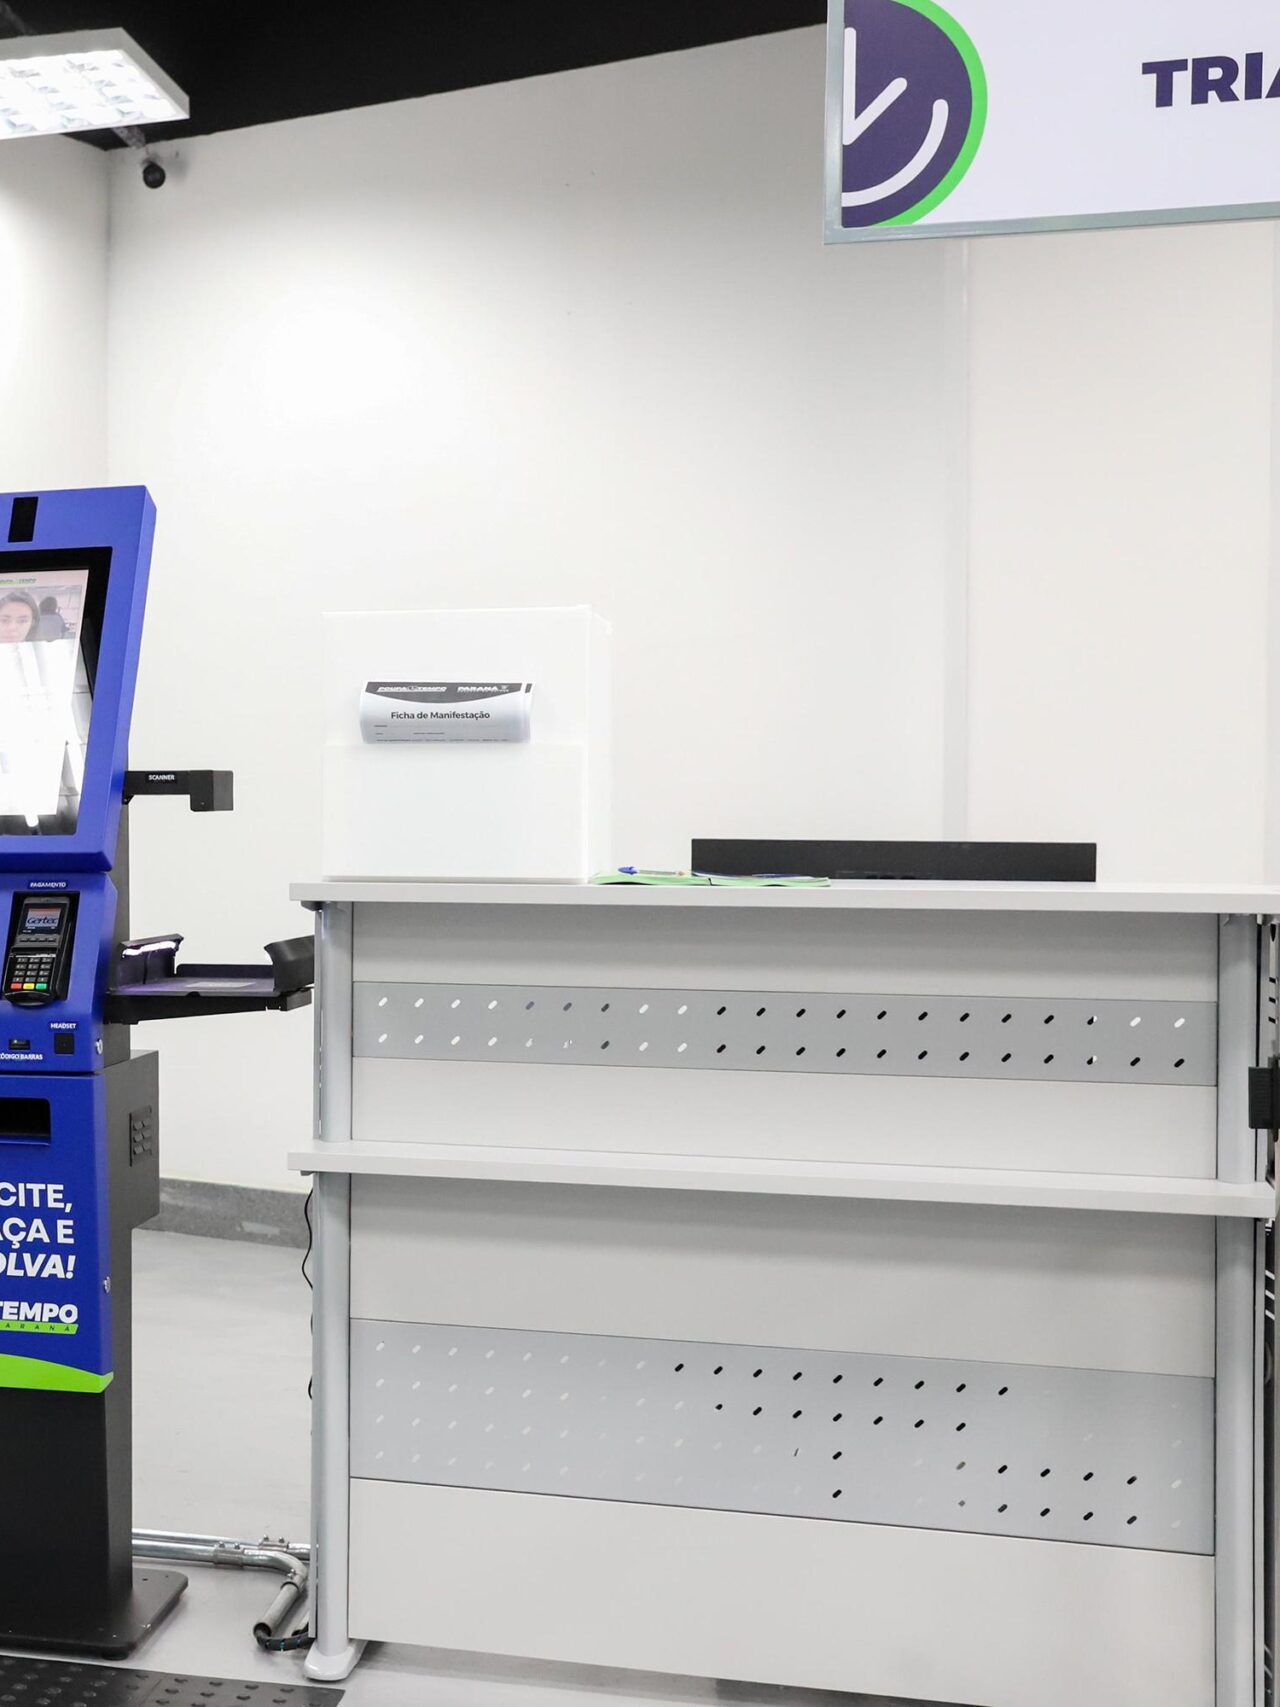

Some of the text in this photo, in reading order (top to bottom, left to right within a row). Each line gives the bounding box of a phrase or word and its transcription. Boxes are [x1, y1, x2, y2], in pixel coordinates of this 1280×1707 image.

[391, 711, 490, 720] Ficha de Manifestação
[57, 1219, 75, 1244] E
